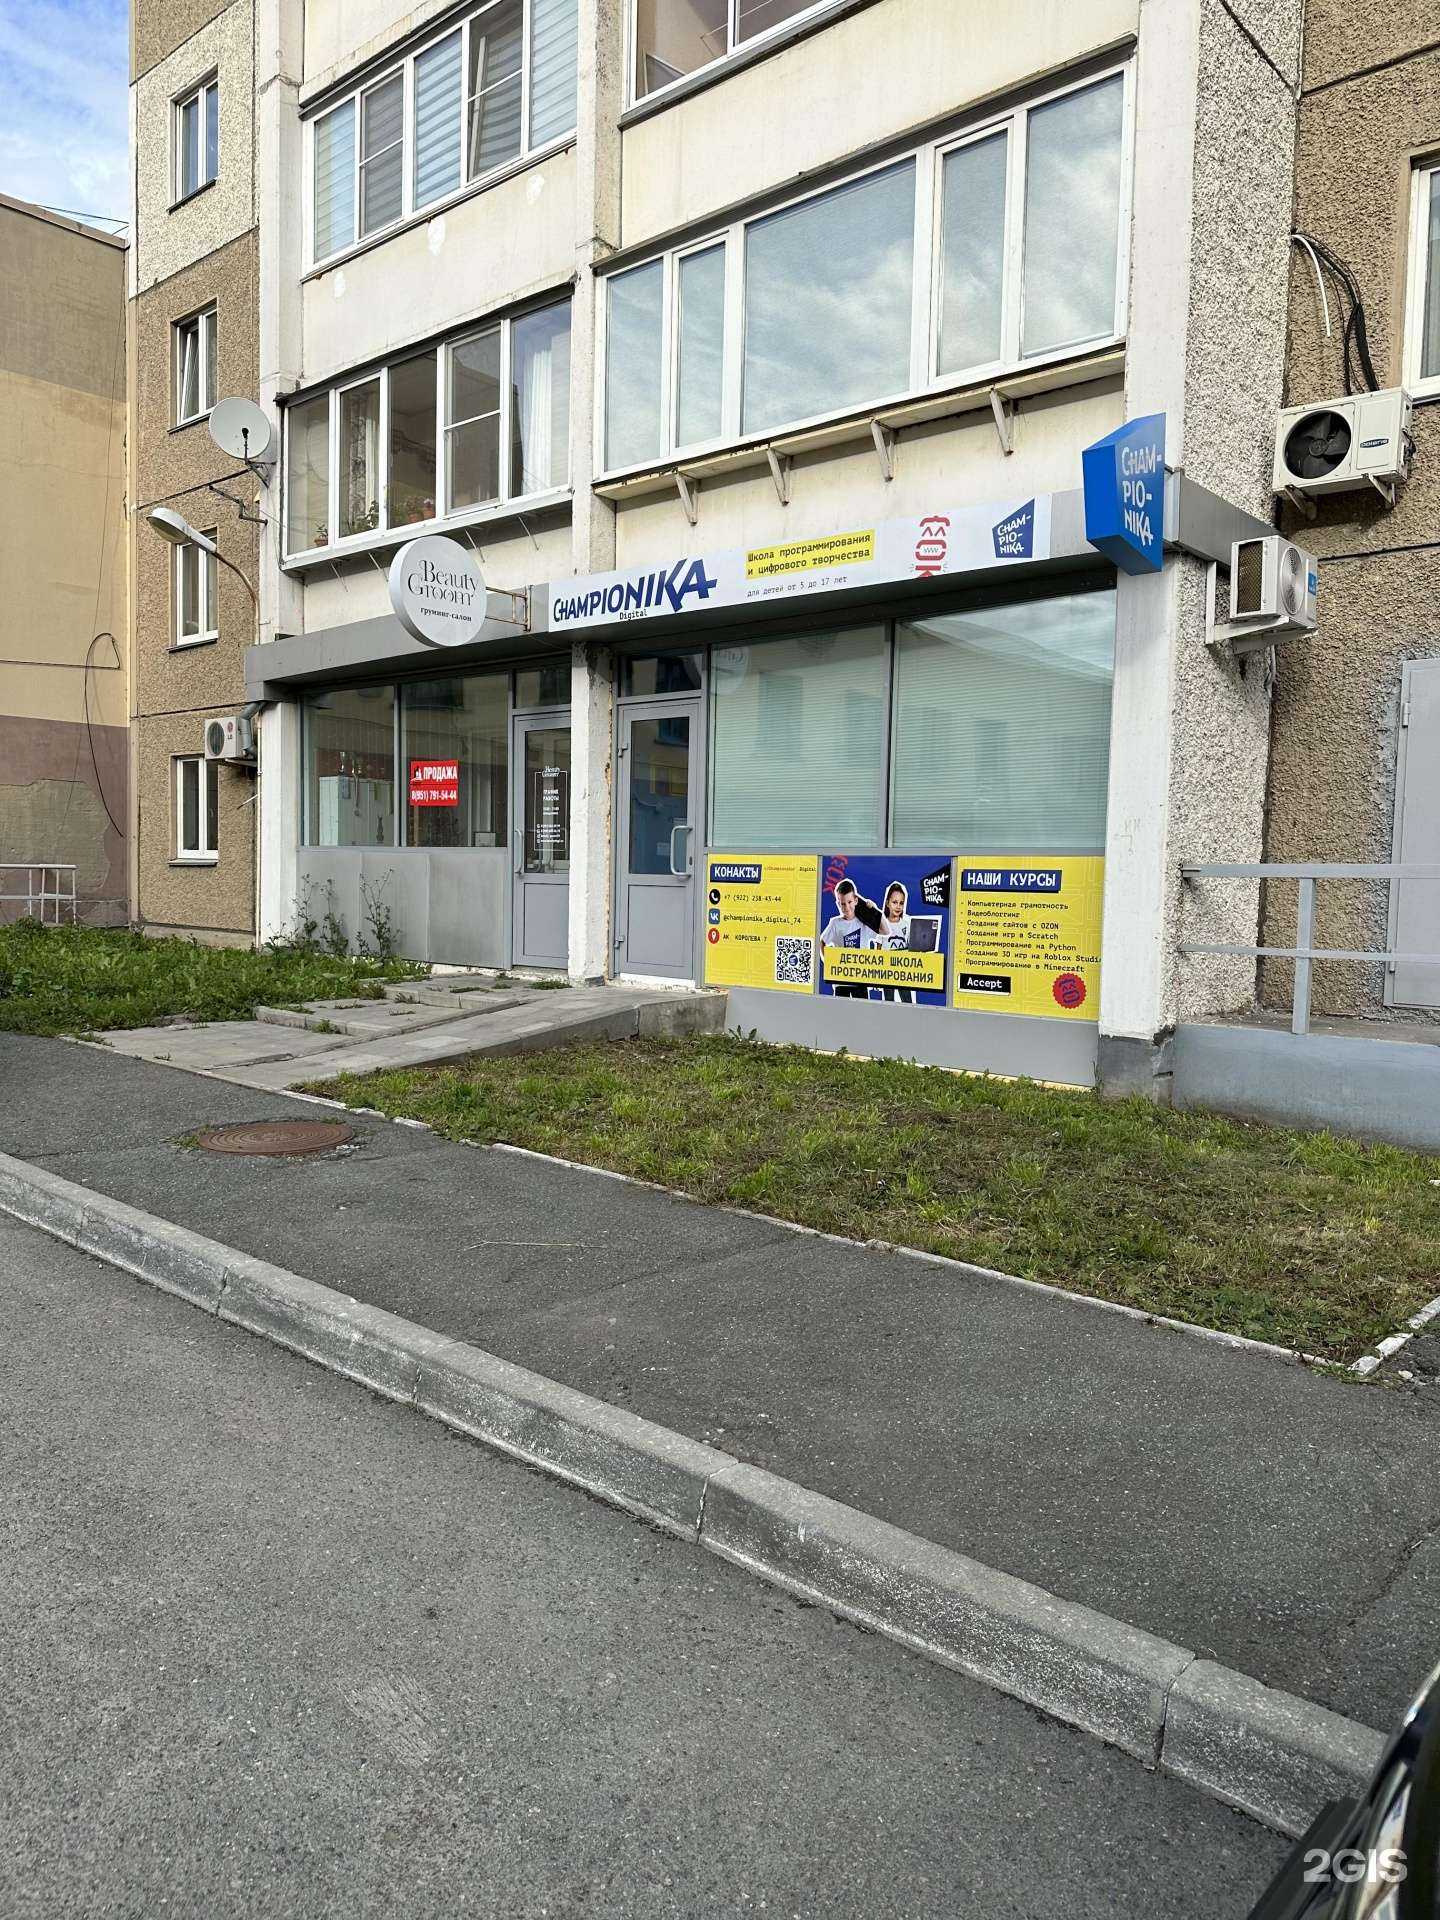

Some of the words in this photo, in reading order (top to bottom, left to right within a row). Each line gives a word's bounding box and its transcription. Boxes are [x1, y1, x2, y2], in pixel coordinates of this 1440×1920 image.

[1121, 443, 1162, 476] CHAM-
[1123, 479, 1152, 508] PIO-
[997, 513, 1032, 538] CHAM-
[1124, 508, 1154, 547] NIKA
[998, 532, 1022, 545] PIO-
[747, 549, 775, 563] Школа
[779, 533, 871, 560] программирования
[999, 543, 1025, 556] NIKA
[747, 568, 754, 576] и
[758, 559, 807, 576] цифрового
[812, 548, 870, 567] творчества
[419, 559, 479, 590] Beauty
[408, 573, 475, 607] Groom
[553, 558, 718, 622] CHAMPIONIKA
[747, 588, 760, 598] для
[763, 584, 784, 595] детей
[787, 583, 797, 591] от
[800, 580, 805, 589] 5
[808, 579, 817, 589] до
[821, 577, 830, 586] 17
[833, 575, 848, 585] лет
[420, 607, 472, 622] груминг-салон
[619, 609, 648, 621] Digital
[423, 766, 458, 782] ПРОДАЖА
[714, 866, 759, 878] КОНАКТЫ
[967, 872, 1001, 885] НАШИ
[1009, 873, 1056, 887] КУРСЫ
[923, 874, 949, 887] CHAM-
[924, 887, 943, 896] PIO-
[925, 895, 944, 904] NIKA
[966, 919, 999, 928] Создание
[1002, 921, 1028, 929] сайтов
[966, 929, 999, 937] Создание
[1027, 932, 1059, 940] Scratch
[966, 939, 1032, 949] Программирование
[1049, 943, 1077, 951] Python
[839, 953, 884, 966] ДЕТСКАЯ
[890, 957, 923, 969] ШКОЛА
[966, 949, 998, 957] Создание
[1044, 953, 1071, 961] Roblox
[965, 958, 1032, 969] Программирование
[1043, 963, 1085, 973] Minecraft
[831, 966, 934, 983] ПРОГРАММИРОВАНИЯ
[966, 977, 1003, 989] Accept
